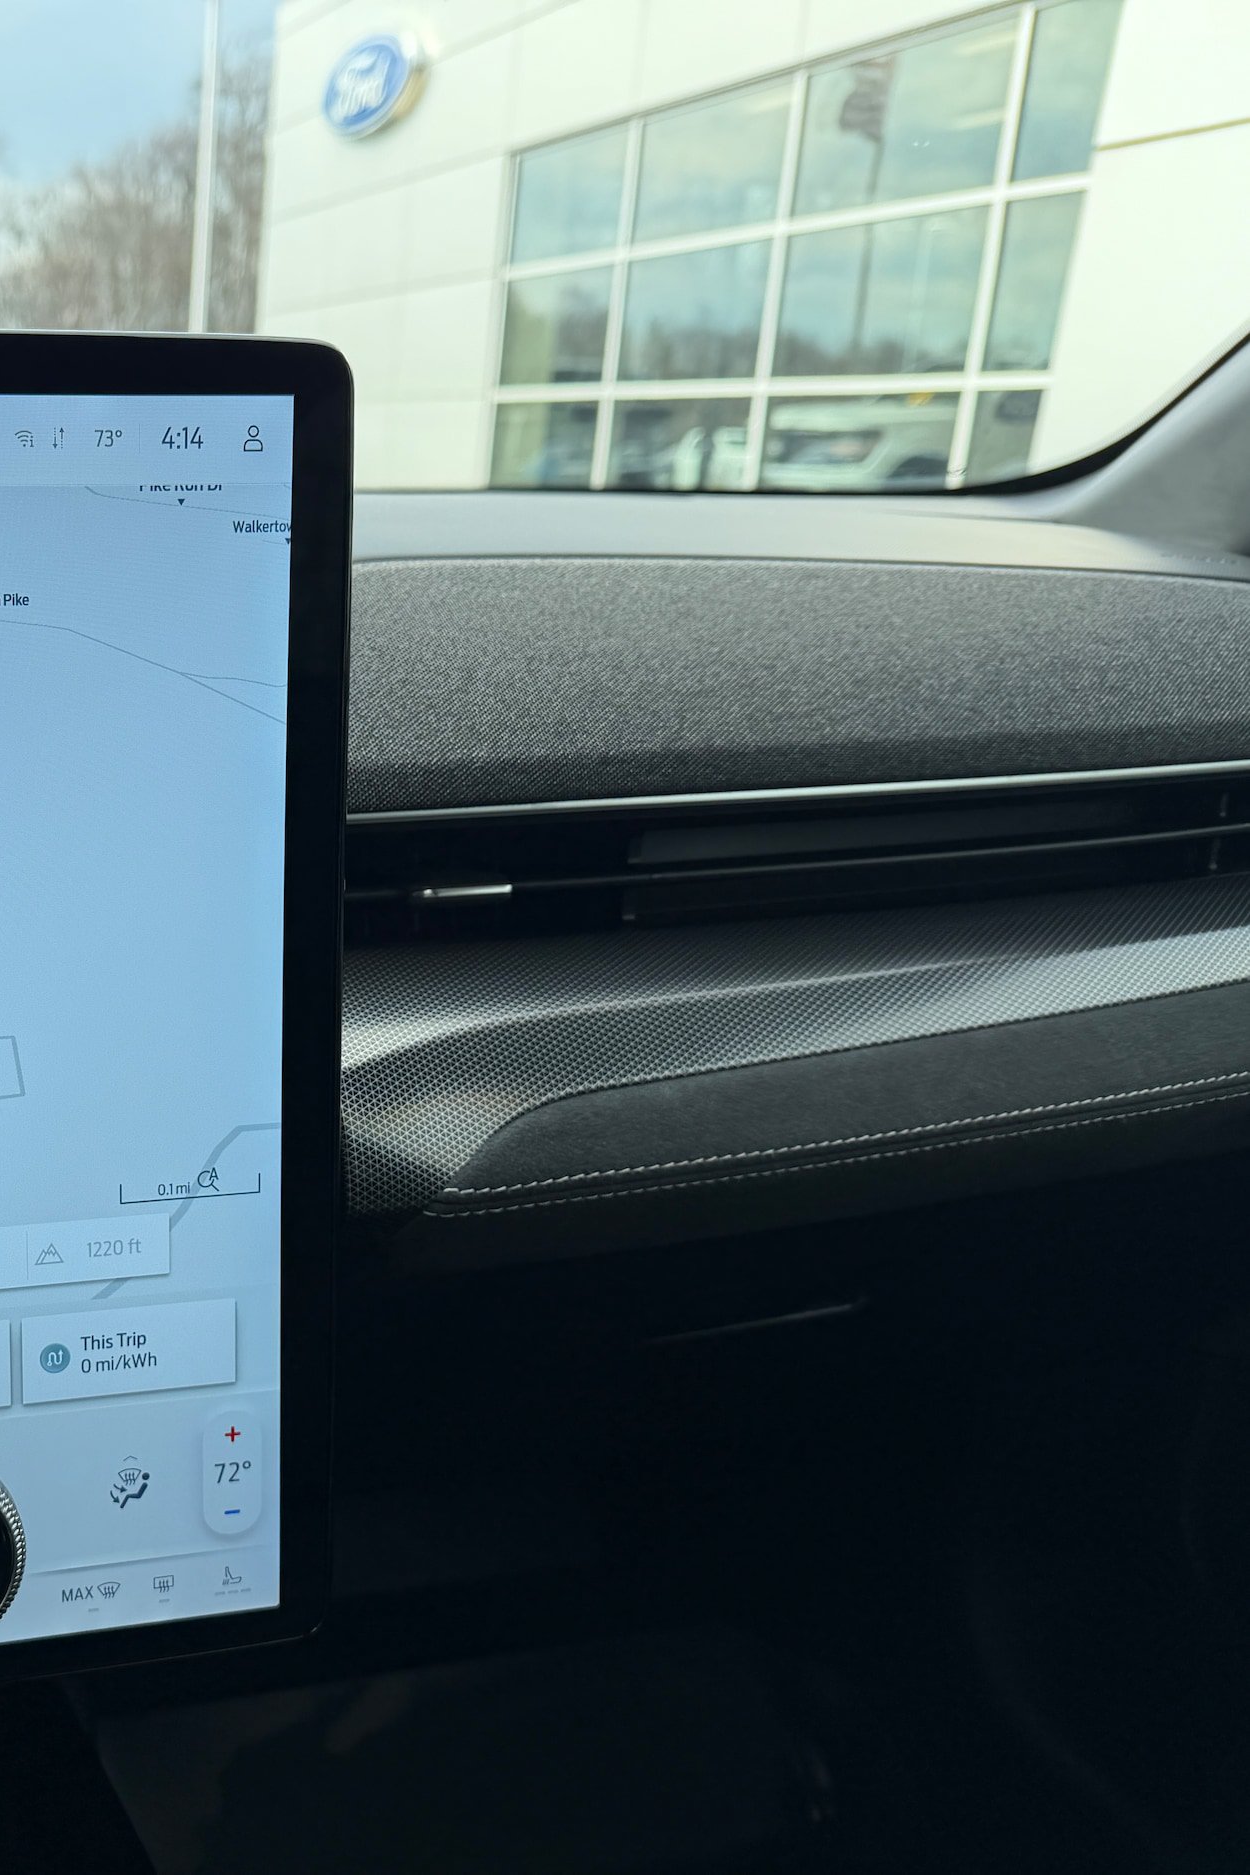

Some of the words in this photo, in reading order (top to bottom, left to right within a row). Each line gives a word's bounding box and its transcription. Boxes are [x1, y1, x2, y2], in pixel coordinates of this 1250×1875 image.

[94, 429, 123, 448] 73°
[161, 426, 204, 450] 4:14
[3, 592, 30, 607] Pike
[86, 1239, 124, 1258] 1220
[127, 1237, 142, 1255] ft
[80, 1334, 114, 1351] This
[116, 1331, 147, 1349] Trip
[81, 1358, 92, 1374] 0
[95, 1351, 157, 1373] mi/kWh
[214, 1460, 252, 1484] 72°
[61, 1585, 94, 1603] MAX
